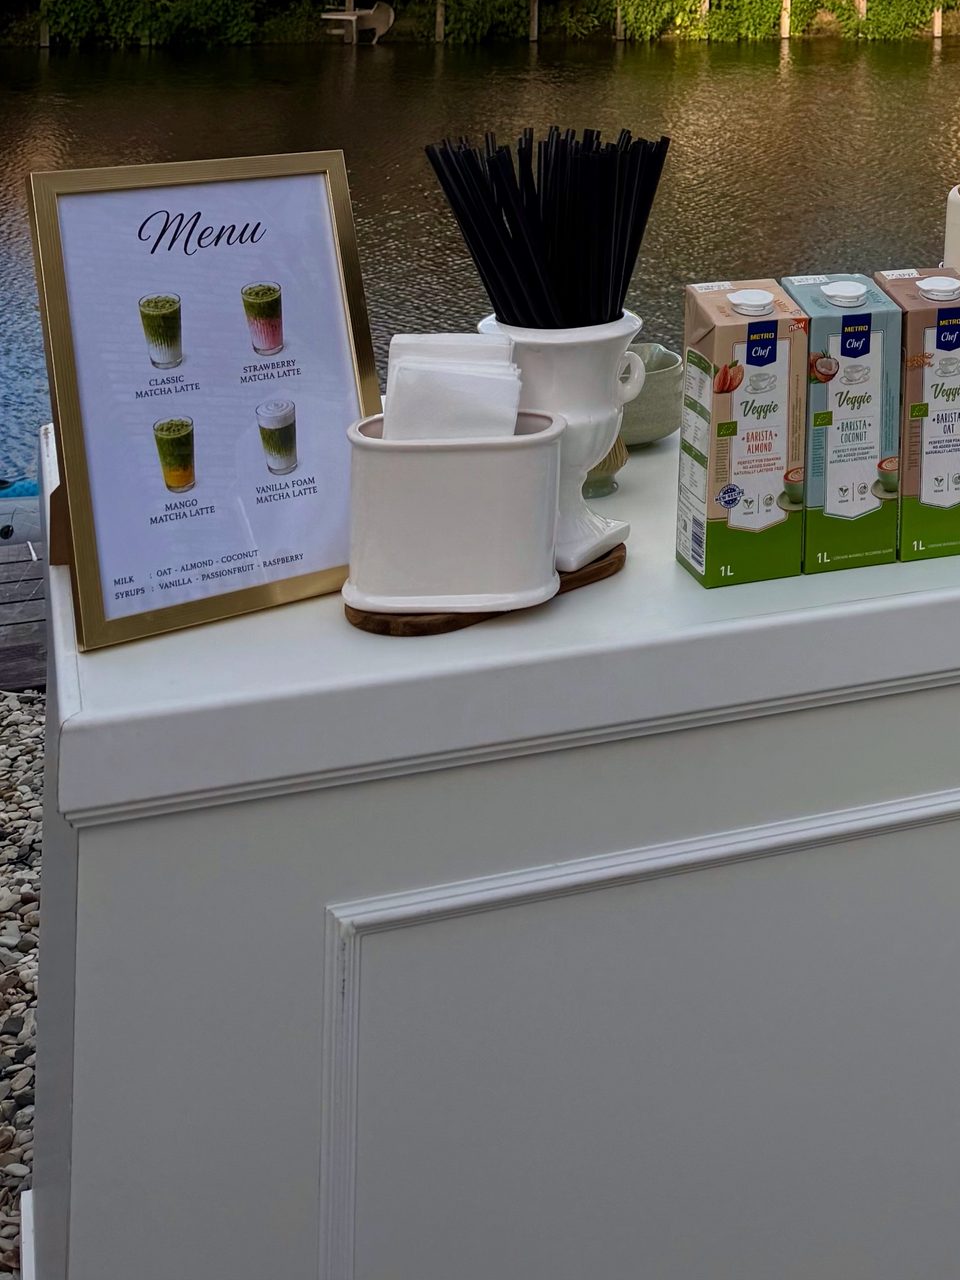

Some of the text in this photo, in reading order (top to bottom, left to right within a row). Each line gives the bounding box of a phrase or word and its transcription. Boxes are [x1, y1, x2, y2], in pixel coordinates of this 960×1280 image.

[138, 210, 266, 256] Menu
[789, 322, 805, 332] new
[940, 318, 960, 326] METRO
[844, 325, 868, 333] METRO
[941, 331, 958, 343] Chef
[846, 338, 866, 350] Chef
[752, 346, 772, 358] Chef
[243, 359, 297, 374] STRAWBERRY
[149, 375, 184, 386] CLASSIC
[240, 367, 302, 384] MATCHA LATTE
[135, 382, 200, 399] MATCHA LATTE
[835, 390, 872, 410] Veggie
[740, 400, 778, 420] Veggie
[841, 420, 867, 432] BARISTA
[943, 423, 954, 434] OAT
[746, 430, 773, 441] BARISTA
[840, 431, 867, 444] COCONUT
[747, 442, 772, 454] ALMOND
[256, 477, 316, 494] VANILLA FOAM
[256, 486, 318, 504] MATCHA LATTE
[715, 494, 726, 503] NEW
[165, 499, 198, 512] MANGO
[150, 506, 215, 525] MATCHA LATTE
[113, 575, 134, 586] MILK
[156, 568, 172, 577] OAT
[180, 559, 214, 572] ALMOND
[221, 550, 259, 564] COCONUT
[115, 587, 145, 600] SYRUPS
[159, 578, 192, 590] VANILLA
[201, 564, 255, 582] PASSIONFRUIT
[262, 553, 304, 568] RASPBERRY
